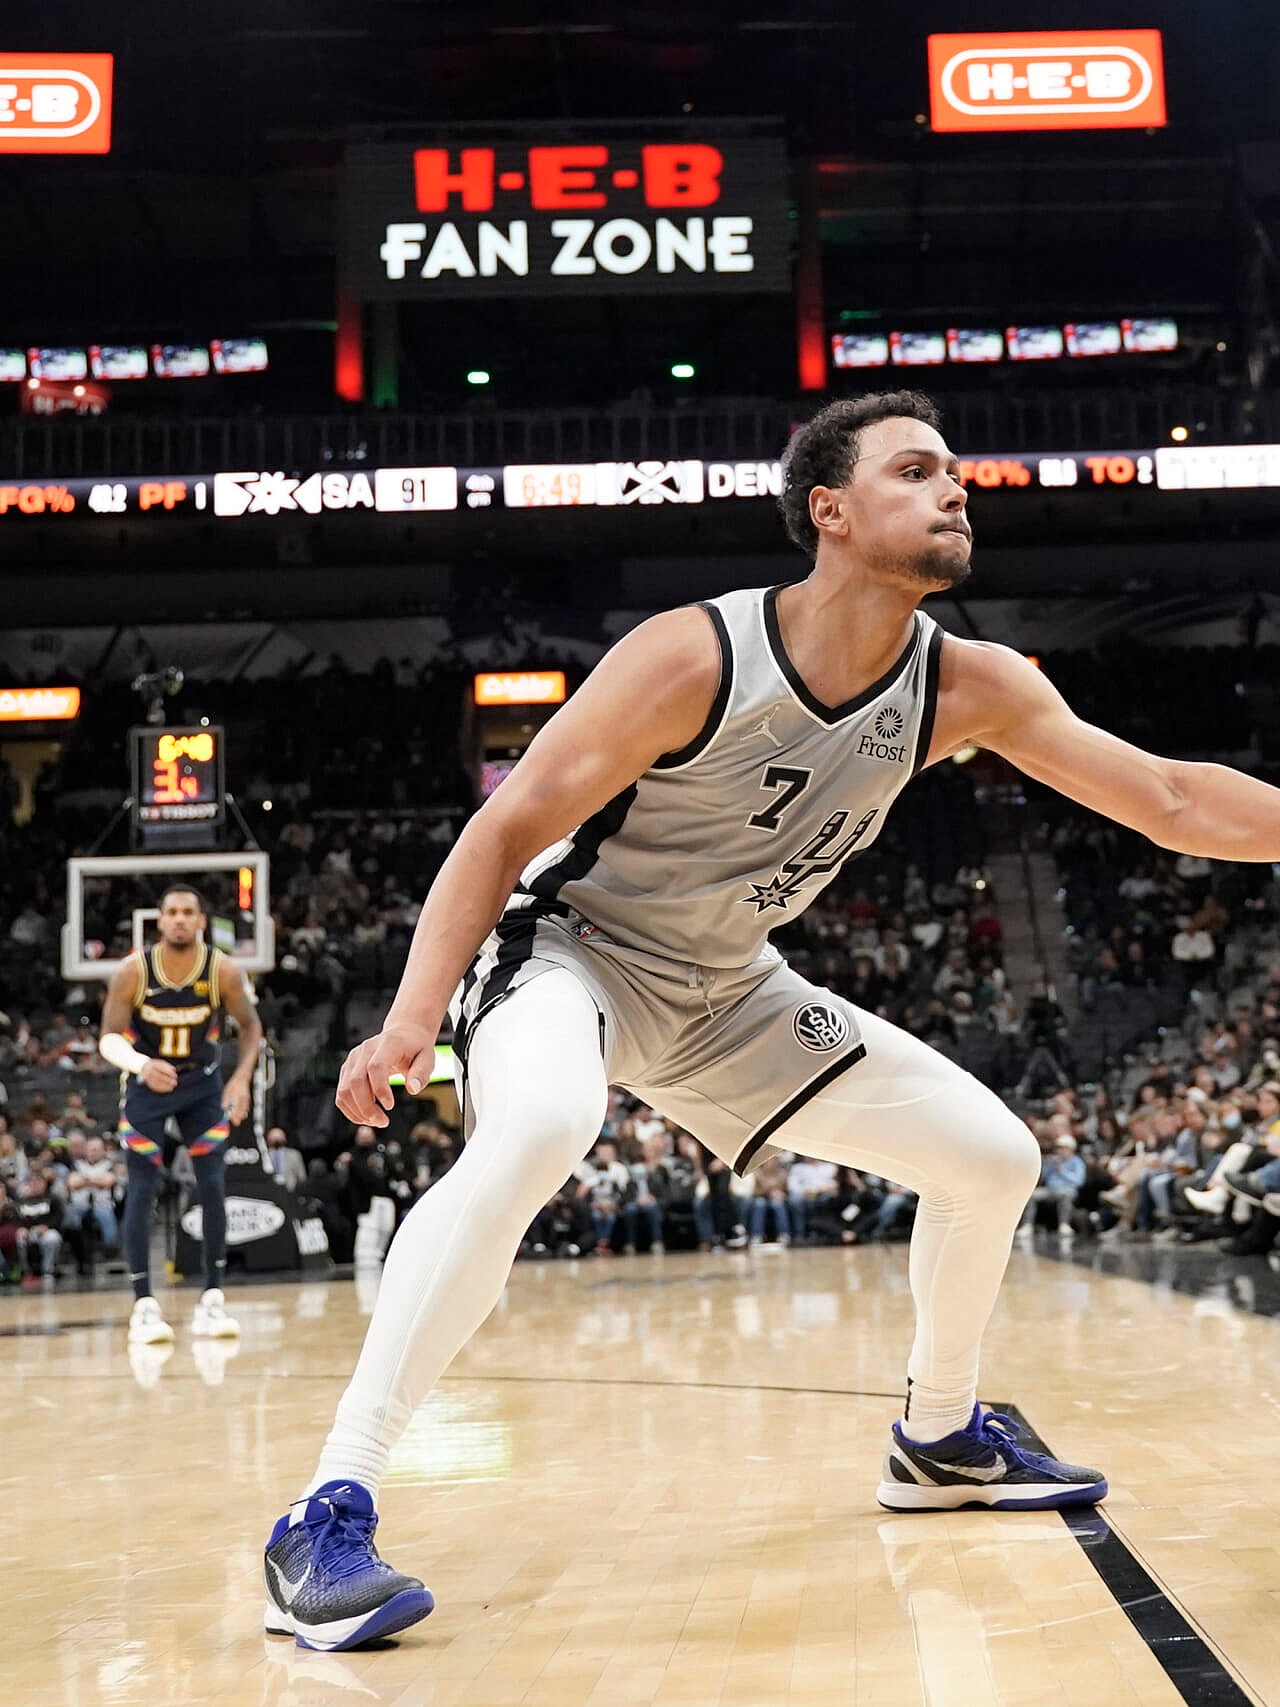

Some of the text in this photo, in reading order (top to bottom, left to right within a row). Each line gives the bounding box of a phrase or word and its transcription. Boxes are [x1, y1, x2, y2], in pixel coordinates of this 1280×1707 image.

[967, 61, 1132, 101] H-E-B
[413, 143, 724, 213] H-E-B
[380, 216, 755, 280] FAN ZONE
[320, 472, 376, 510] SA
[401, 477, 427, 504] 91
[708, 462, 786, 499] DEN
[1084, 455, 1134, 484] TO
[138, 481, 187, 511] PF
[856, 734, 907, 763] Frost
[744, 763, 815, 834] 7
[159, 1026, 191, 1058] 11
